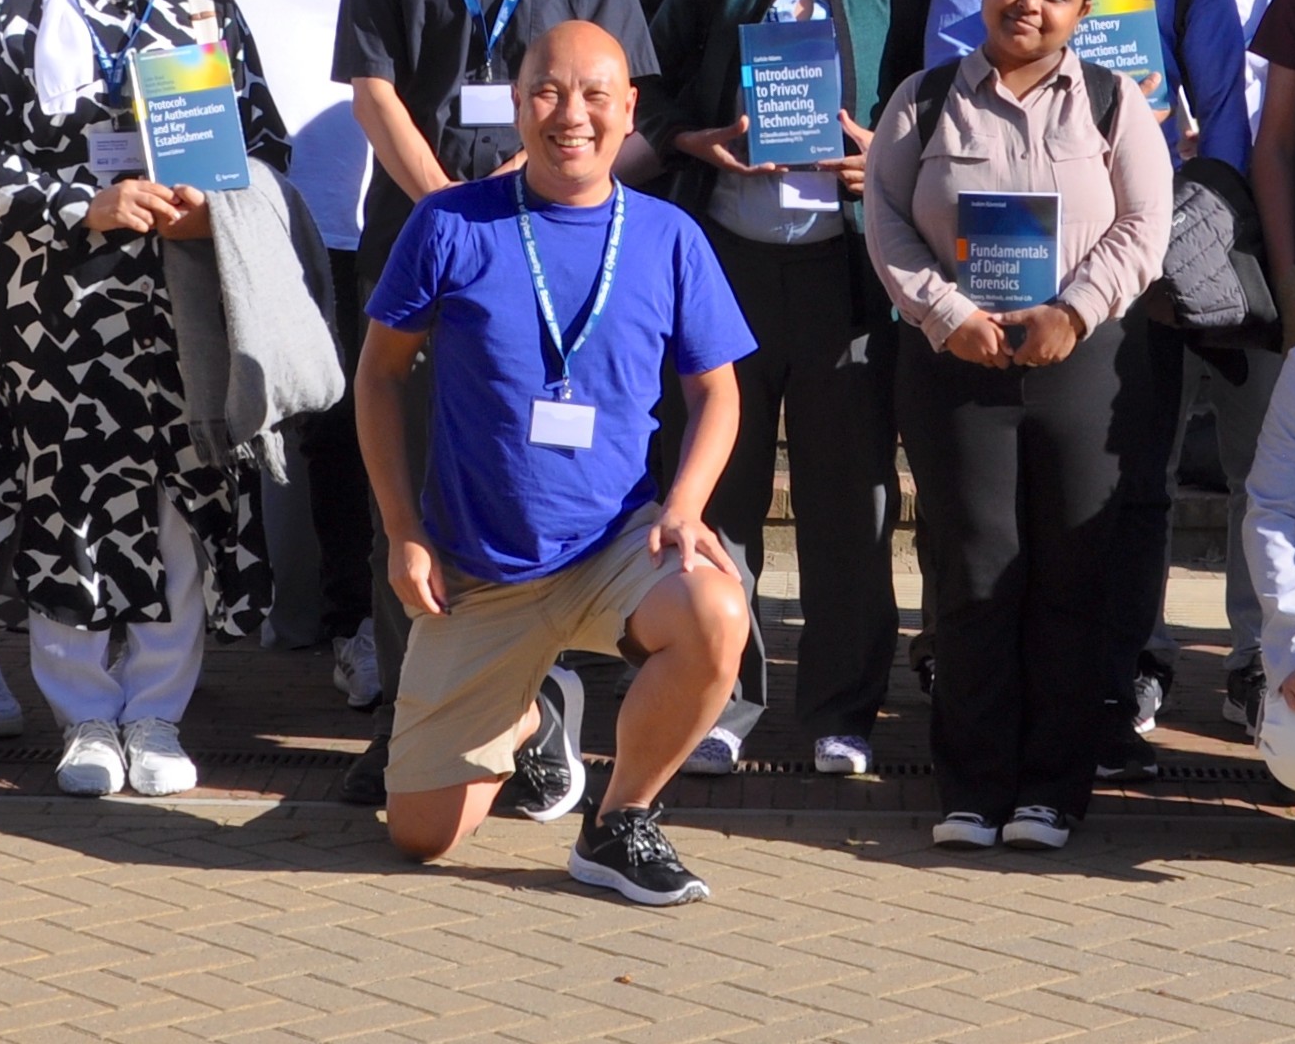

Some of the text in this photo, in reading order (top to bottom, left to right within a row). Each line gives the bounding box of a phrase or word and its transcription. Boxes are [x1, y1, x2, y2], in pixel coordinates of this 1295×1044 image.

[1089, 19, 1120, 33] Theory
[1074, 32, 1107, 47] of Hash
[1075, 40, 1137, 58] Functions and
[1116, 53, 1148, 67] Oracles
[755, 65, 823, 83] Introduction
[756, 82, 810, 98] to Privacy
[148, 96, 187, 112] Protocols
[757, 98, 815, 114] Enhancing
[150, 103, 226, 124] for Authentication
[758, 112, 829, 129] Technologies
[153, 121, 186, 135] and Key
[155, 129, 214, 148] Establishment
[970, 243, 1049, 259] Fundamentals
[970, 259, 1020, 277] of Digital
[970, 275, 1020, 291] Forensics
